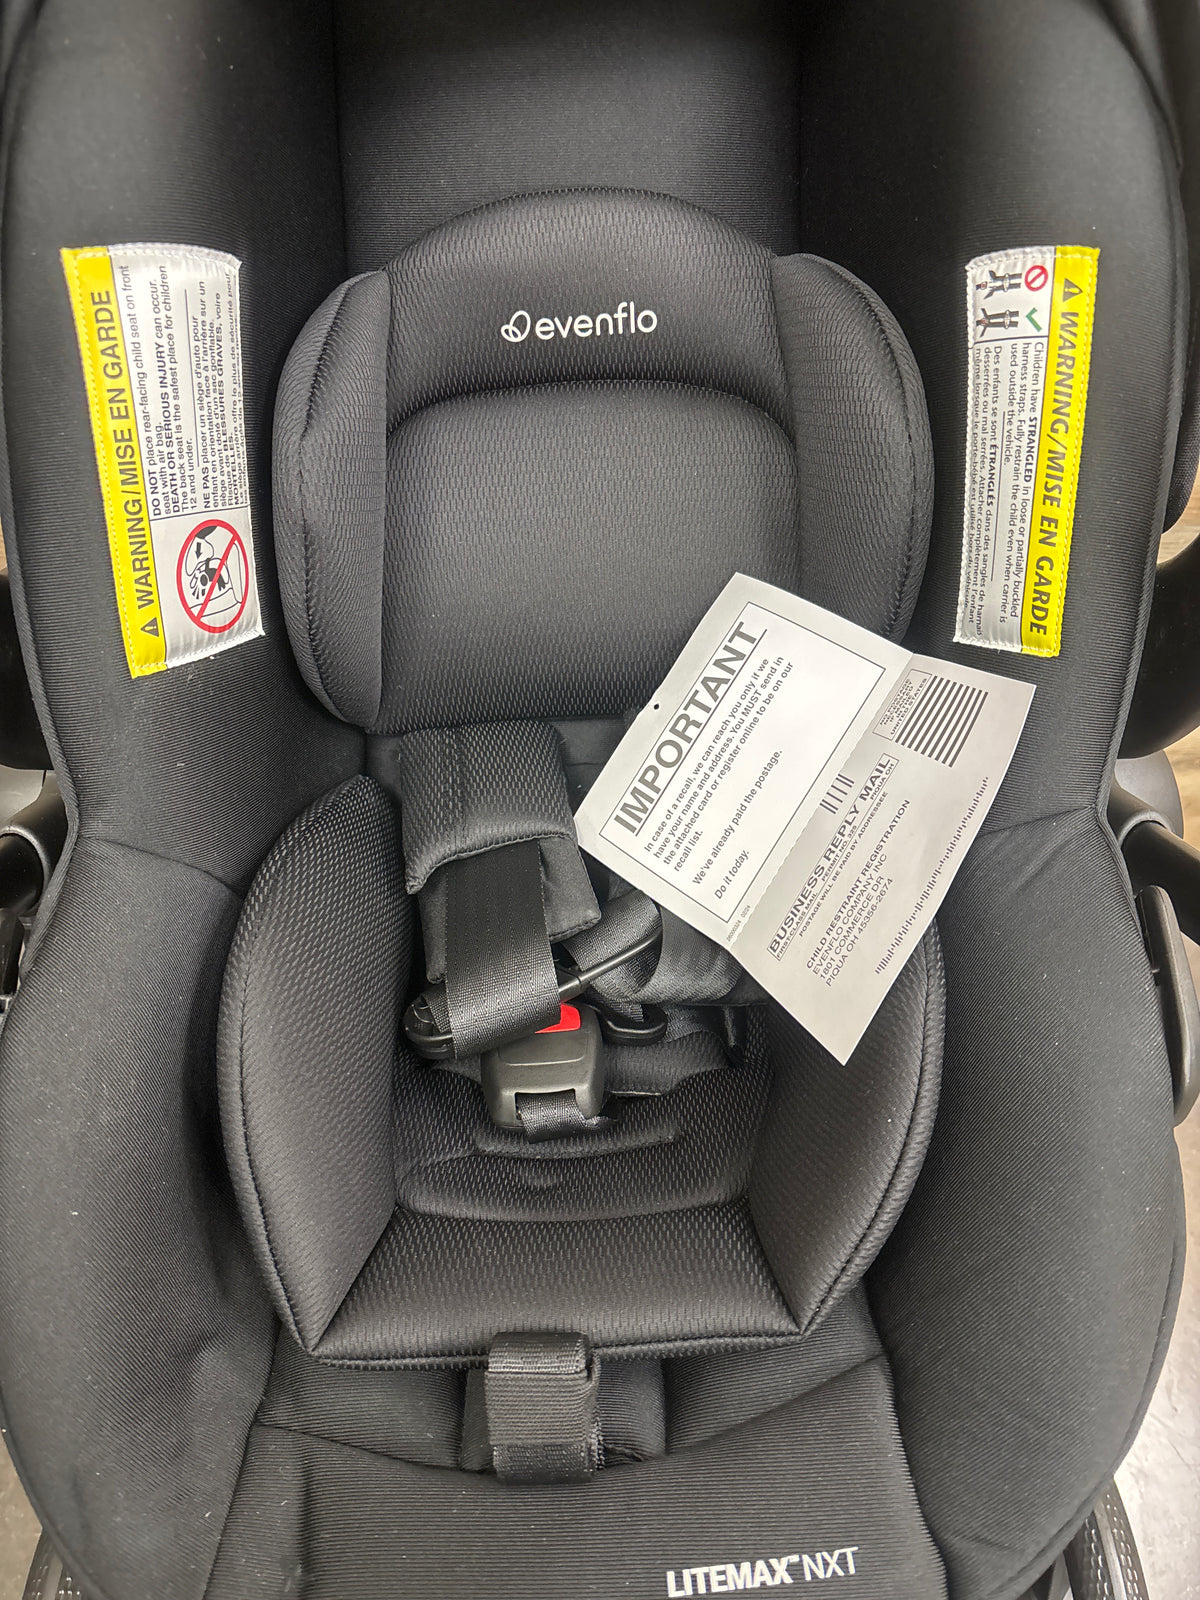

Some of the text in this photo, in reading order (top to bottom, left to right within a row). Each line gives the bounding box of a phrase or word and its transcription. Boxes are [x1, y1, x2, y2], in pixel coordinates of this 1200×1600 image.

[118, 265, 132, 291] front
[198, 281, 206, 296] un
[125, 295, 136, 310] on
[126, 313, 140, 338] seat
[154, 317, 164, 339] can
[192, 315, 203, 342] pour
[535, 301, 658, 340] evenflo
[130, 341, 144, 369] child
[154, 342, 169, 389] INJURY
[993, 345, 1003, 366] Des
[1009, 343, 1019, 367] used
[1020, 342, 1032, 381] harness
[159, 265, 189, 513] The back seat is the safest place for children
[991, 367, 1001, 405] enfants
[1007, 369, 1017, 407] outside
[160, 391, 174, 448] SERIOUS
[199, 414, 206, 428] un
[982, 400, 989, 414] ou
[990, 407, 998, 418] se
[1006, 409, 1016, 427] the
[206, 401, 217, 457] orientation
[981, 416, 989, 435] mal
[989, 420, 997, 442] sont
[1012, 419, 1026, 443] Fully
[90, 290, 155, 610] WARNING/MISE EN GARDE
[145, 435, 158, 466] place
[156, 449, 166, 464] air
[166, 451, 176, 470] OR
[200, 430, 211, 464] placer
[211, 459, 218, 473] en
[1012, 445, 1022, 481] restrain
[1029, 311, 1079, 636] WARNING/MISE EN GARDE
[147, 469, 159, 495] NOT
[158, 466, 169, 489] with
[187, 474, 197, 495] and
[201, 466, 210, 490] PAS
[211, 475, 219, 508] enfant
[1009, 341, 1044, 618] Children have STRANGLED in loose or partially buckled
[161, 491, 172, 515] seat
[168, 472, 181, 513] DEATH
[189, 497, 198, 510] 12
[203, 492, 211, 509] NE
[977, 475, 986, 516] Attacher
[1010, 484, 1021, 501] the
[151, 497, 162, 517] DO
[984, 509, 993, 533] dans
[1008, 502, 1019, 527] child
[983, 534, 991, 551] des
[1006, 529, 1015, 552] even
[979, 553, 988, 588] sangles
[1003, 554, 1014, 582] when
[978, 589, 986, 602] de
[1000, 583, 1010, 614] carrier
[999, 615, 1008, 624] is
[613, 621, 758, 834] IMPORTANT
[644, 842, 655, 852] In
[651, 820, 668, 842] case
[665, 809, 674, 820] of
[676, 777, 697, 803] recall,
[692, 762, 704, 775] we
[701, 745, 715, 762] can
[712, 719, 731, 745] reach
[728, 701, 742, 720] you
[740, 680, 756, 701] only
[751, 672, 760, 681] if
[757, 659, 769, 672] we
[653, 656, 785, 859] have your name and address. You MUST send in
[663, 661, 794, 865] the attached card or register online to be on our
[692, 750, 783, 885] We've already paid the postage.
[674, 831, 704, 872] recall list.
[766, 759, 891, 953] BUSINESS REPLY MAIL
[714, 849, 750, 900] Do it today.
[806, 799, 911, 969] CHILD RESTRAINT REGISTRATION
[812, 853, 887, 975] EVENFLO COMPANY INC
[820, 875, 885, 979] 1801 COMMERCE DR
[825, 954, 849, 987] PIQUA
[846, 934, 860, 953] OH
[802, 1546, 859, 1581] NXT
